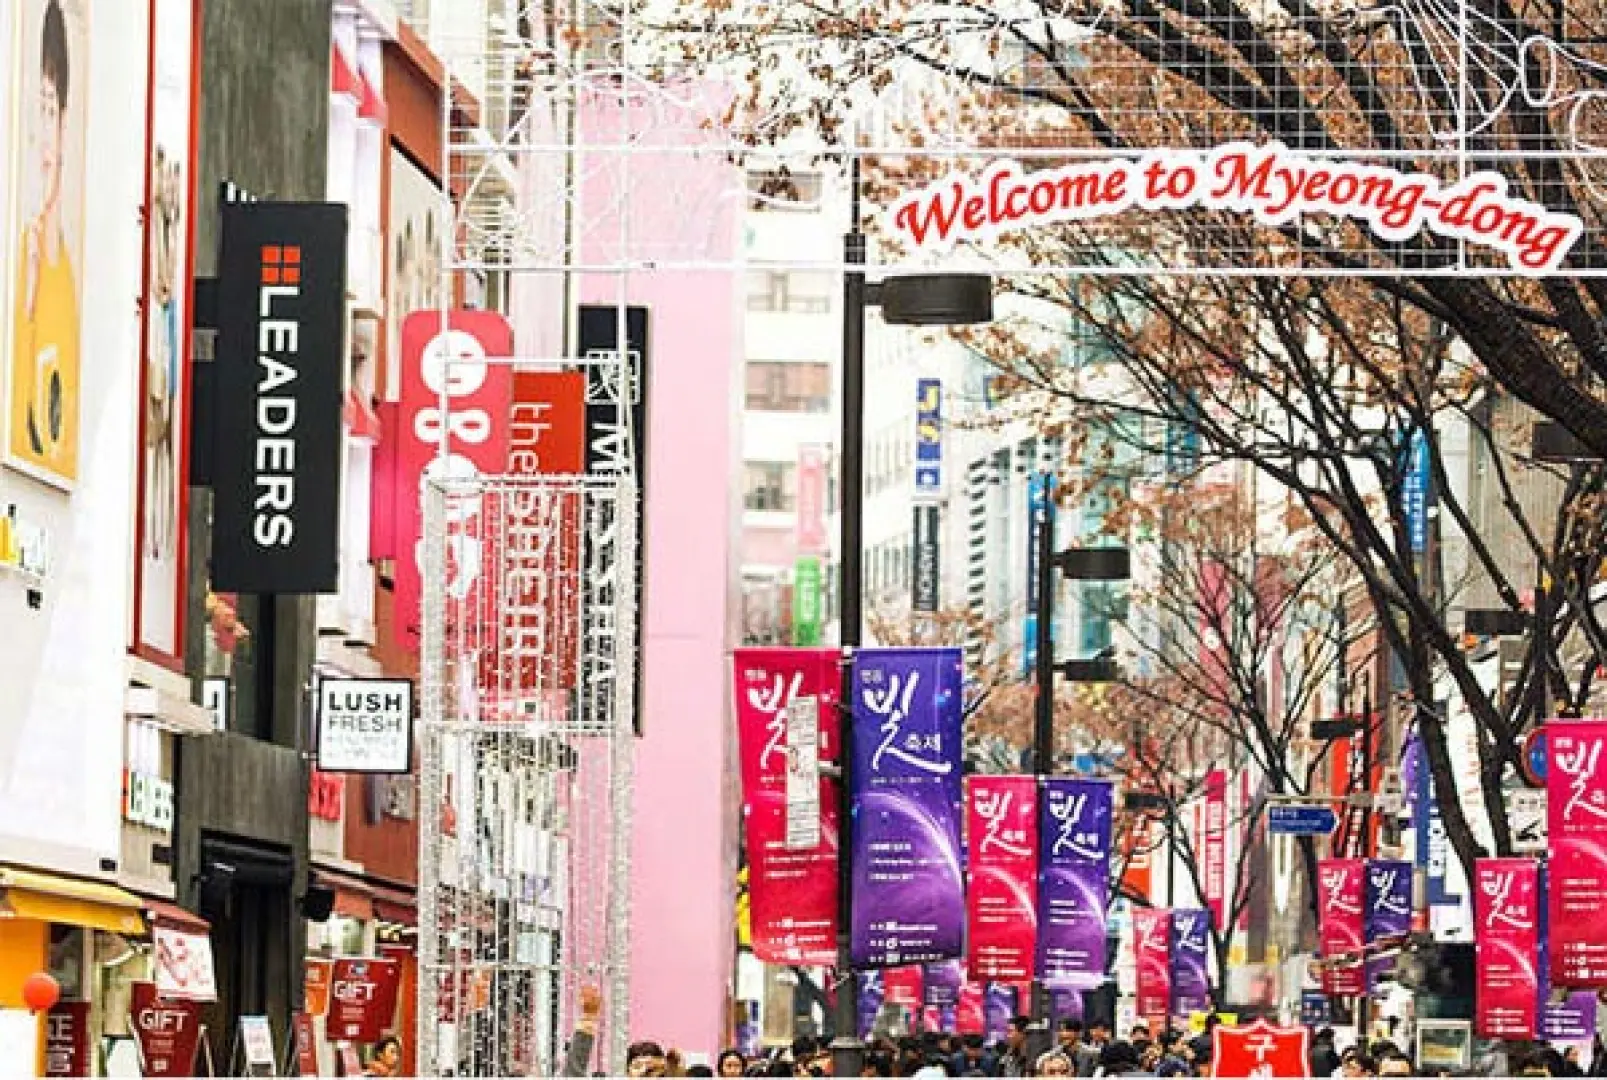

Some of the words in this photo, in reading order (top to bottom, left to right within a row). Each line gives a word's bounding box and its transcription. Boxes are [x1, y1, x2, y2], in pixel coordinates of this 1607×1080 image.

[895, 169, 1127, 245] Welcome
[1146, 161, 1196, 199] to
[1210, 153, 1571, 267] Myeong-dong
[255, 287, 298, 546] LEADERS
[508, 402, 552, 472] the
[328, 691, 403, 712] LUSH
[328, 715, 403, 732] FRESH
[334, 980, 378, 1001] GIFT
[138, 1007, 190, 1033] GIFT
